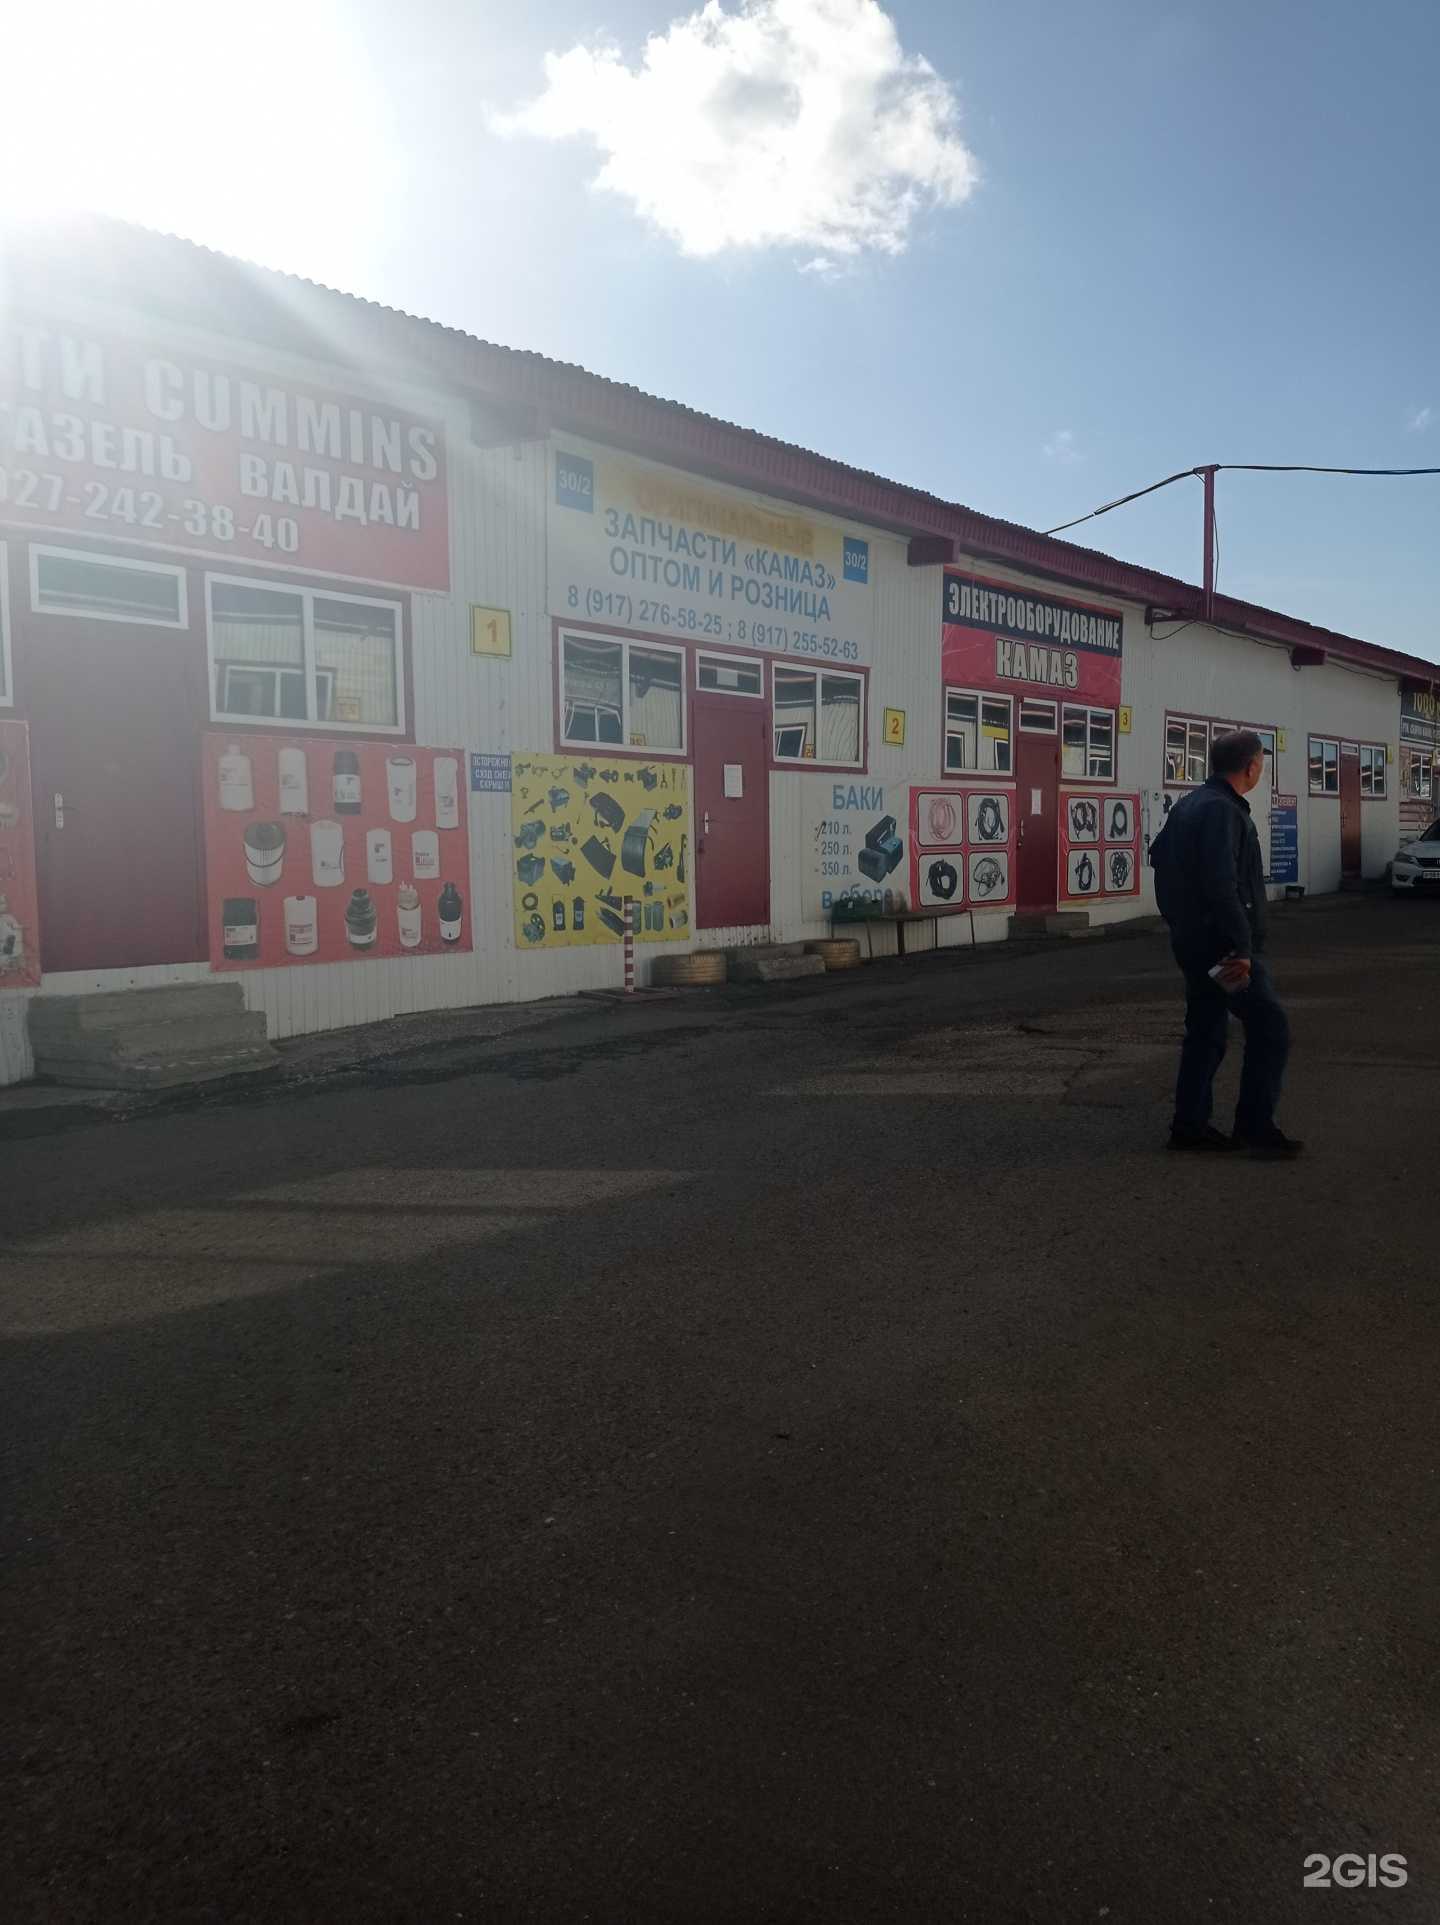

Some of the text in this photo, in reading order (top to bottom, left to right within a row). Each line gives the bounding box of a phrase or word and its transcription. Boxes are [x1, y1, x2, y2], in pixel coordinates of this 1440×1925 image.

[143, 357, 438, 482] CUMMINS
[0, 403, 420, 532] АЗЕЛЬ ВАЛДАЙ
[558, 468, 592, 496] 30/2
[603, 507, 836, 591] ЗАПЧАСТИ «КАМАЗ»
[609, 546, 831, 623] ОПТОМ И РОЗНИЦА
[487, 618, 498, 643] 1
[567, 584, 579, 607] 8
[585, 587, 633, 624] (917)
[639, 600, 723, 636] 276-58-25
[737, 619, 747, 640] 8
[751, 624, 789, 652] (917)
[792, 630, 859, 661] 255-52-63
[948, 582, 1120, 651] ЭЛЕКТРООБОРУДОВАНИЕ
[995, 636, 1079, 691] КАМАЗ
[890, 717, 900, 735] 2
[1121, 711, 1129, 727] 3
[832, 784, 884, 812] БАКИ
[821, 841, 839, 856] 250
[821, 861, 839, 876] 350
